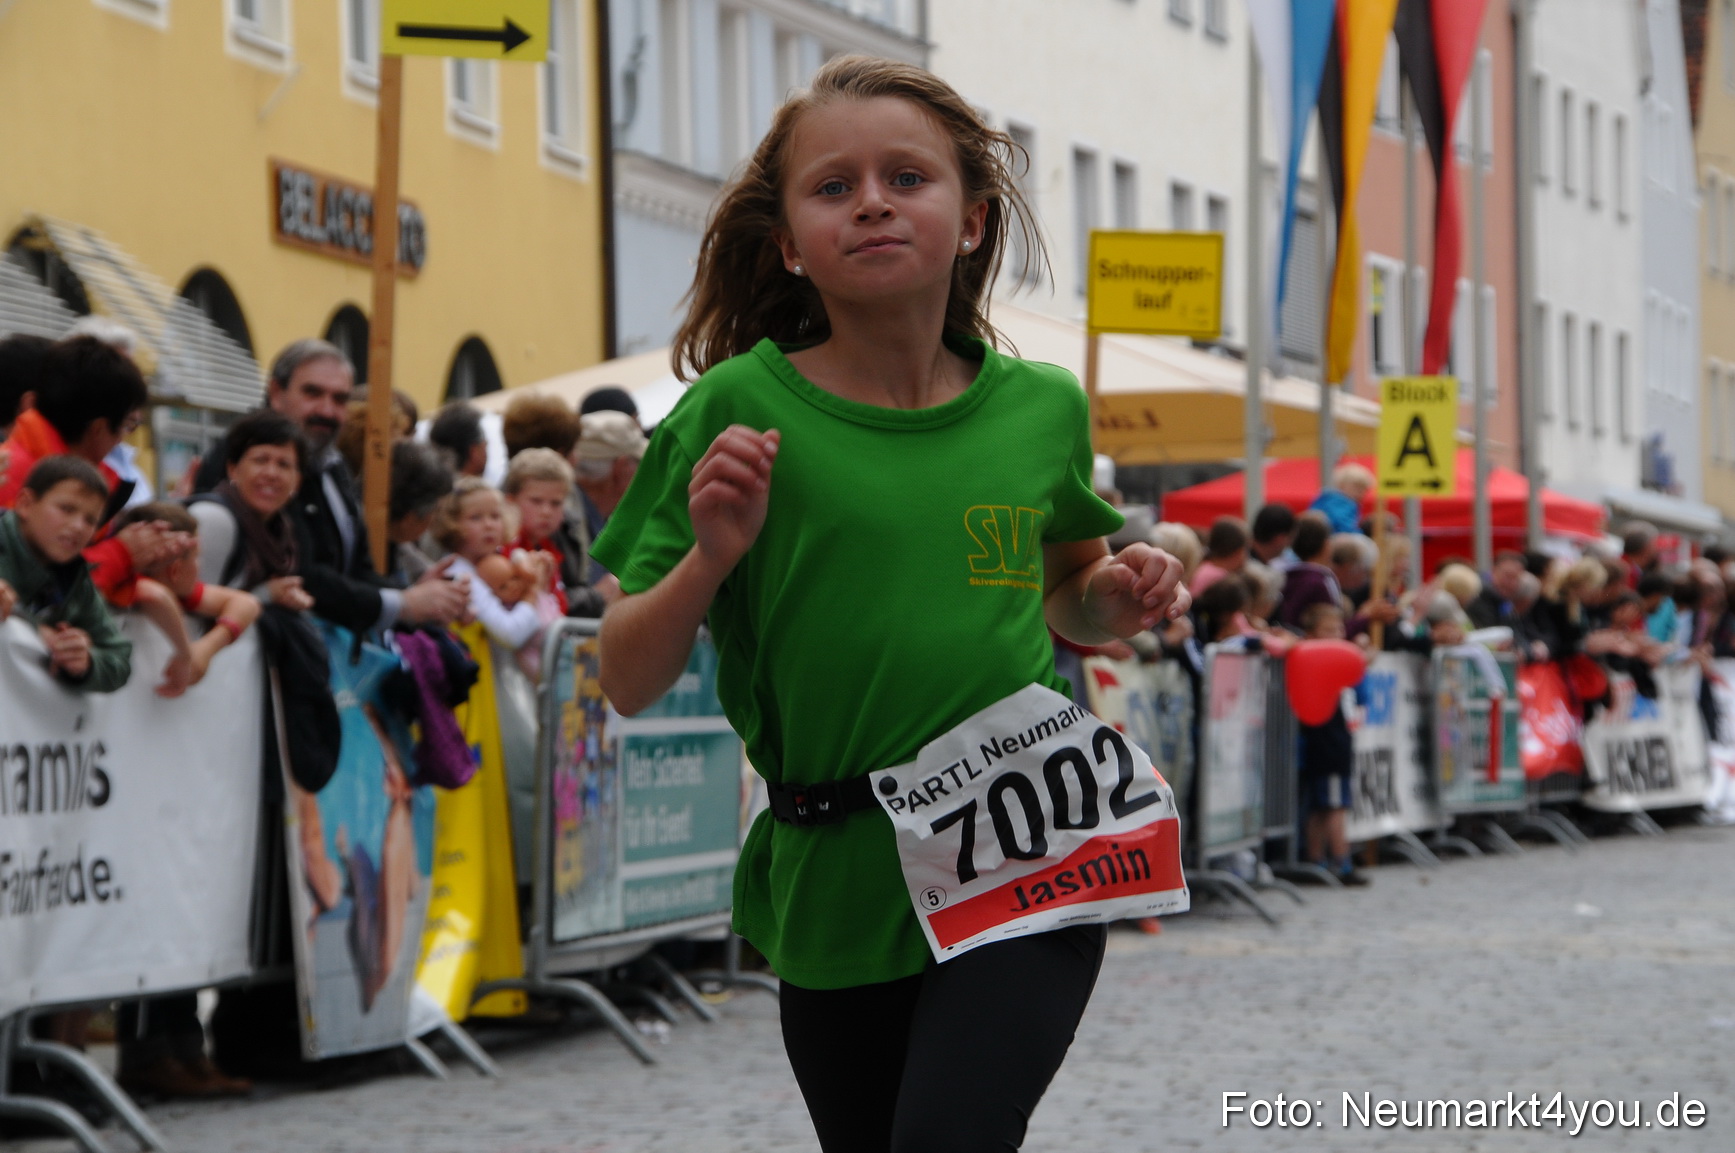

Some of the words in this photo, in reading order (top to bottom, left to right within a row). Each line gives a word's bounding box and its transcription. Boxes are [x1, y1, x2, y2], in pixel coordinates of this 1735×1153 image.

[1098, 257, 1214, 286] Schnupper-
[1132, 287, 1172, 311] lauf
[1389, 380, 1449, 402] Block
[1395, 413, 1437, 469] A
[886, 757, 982, 815] PARTL
[929, 725, 1162, 885] 7002
[927, 889, 940, 907] 5
[1009, 843, 1150, 913] Jasmin
